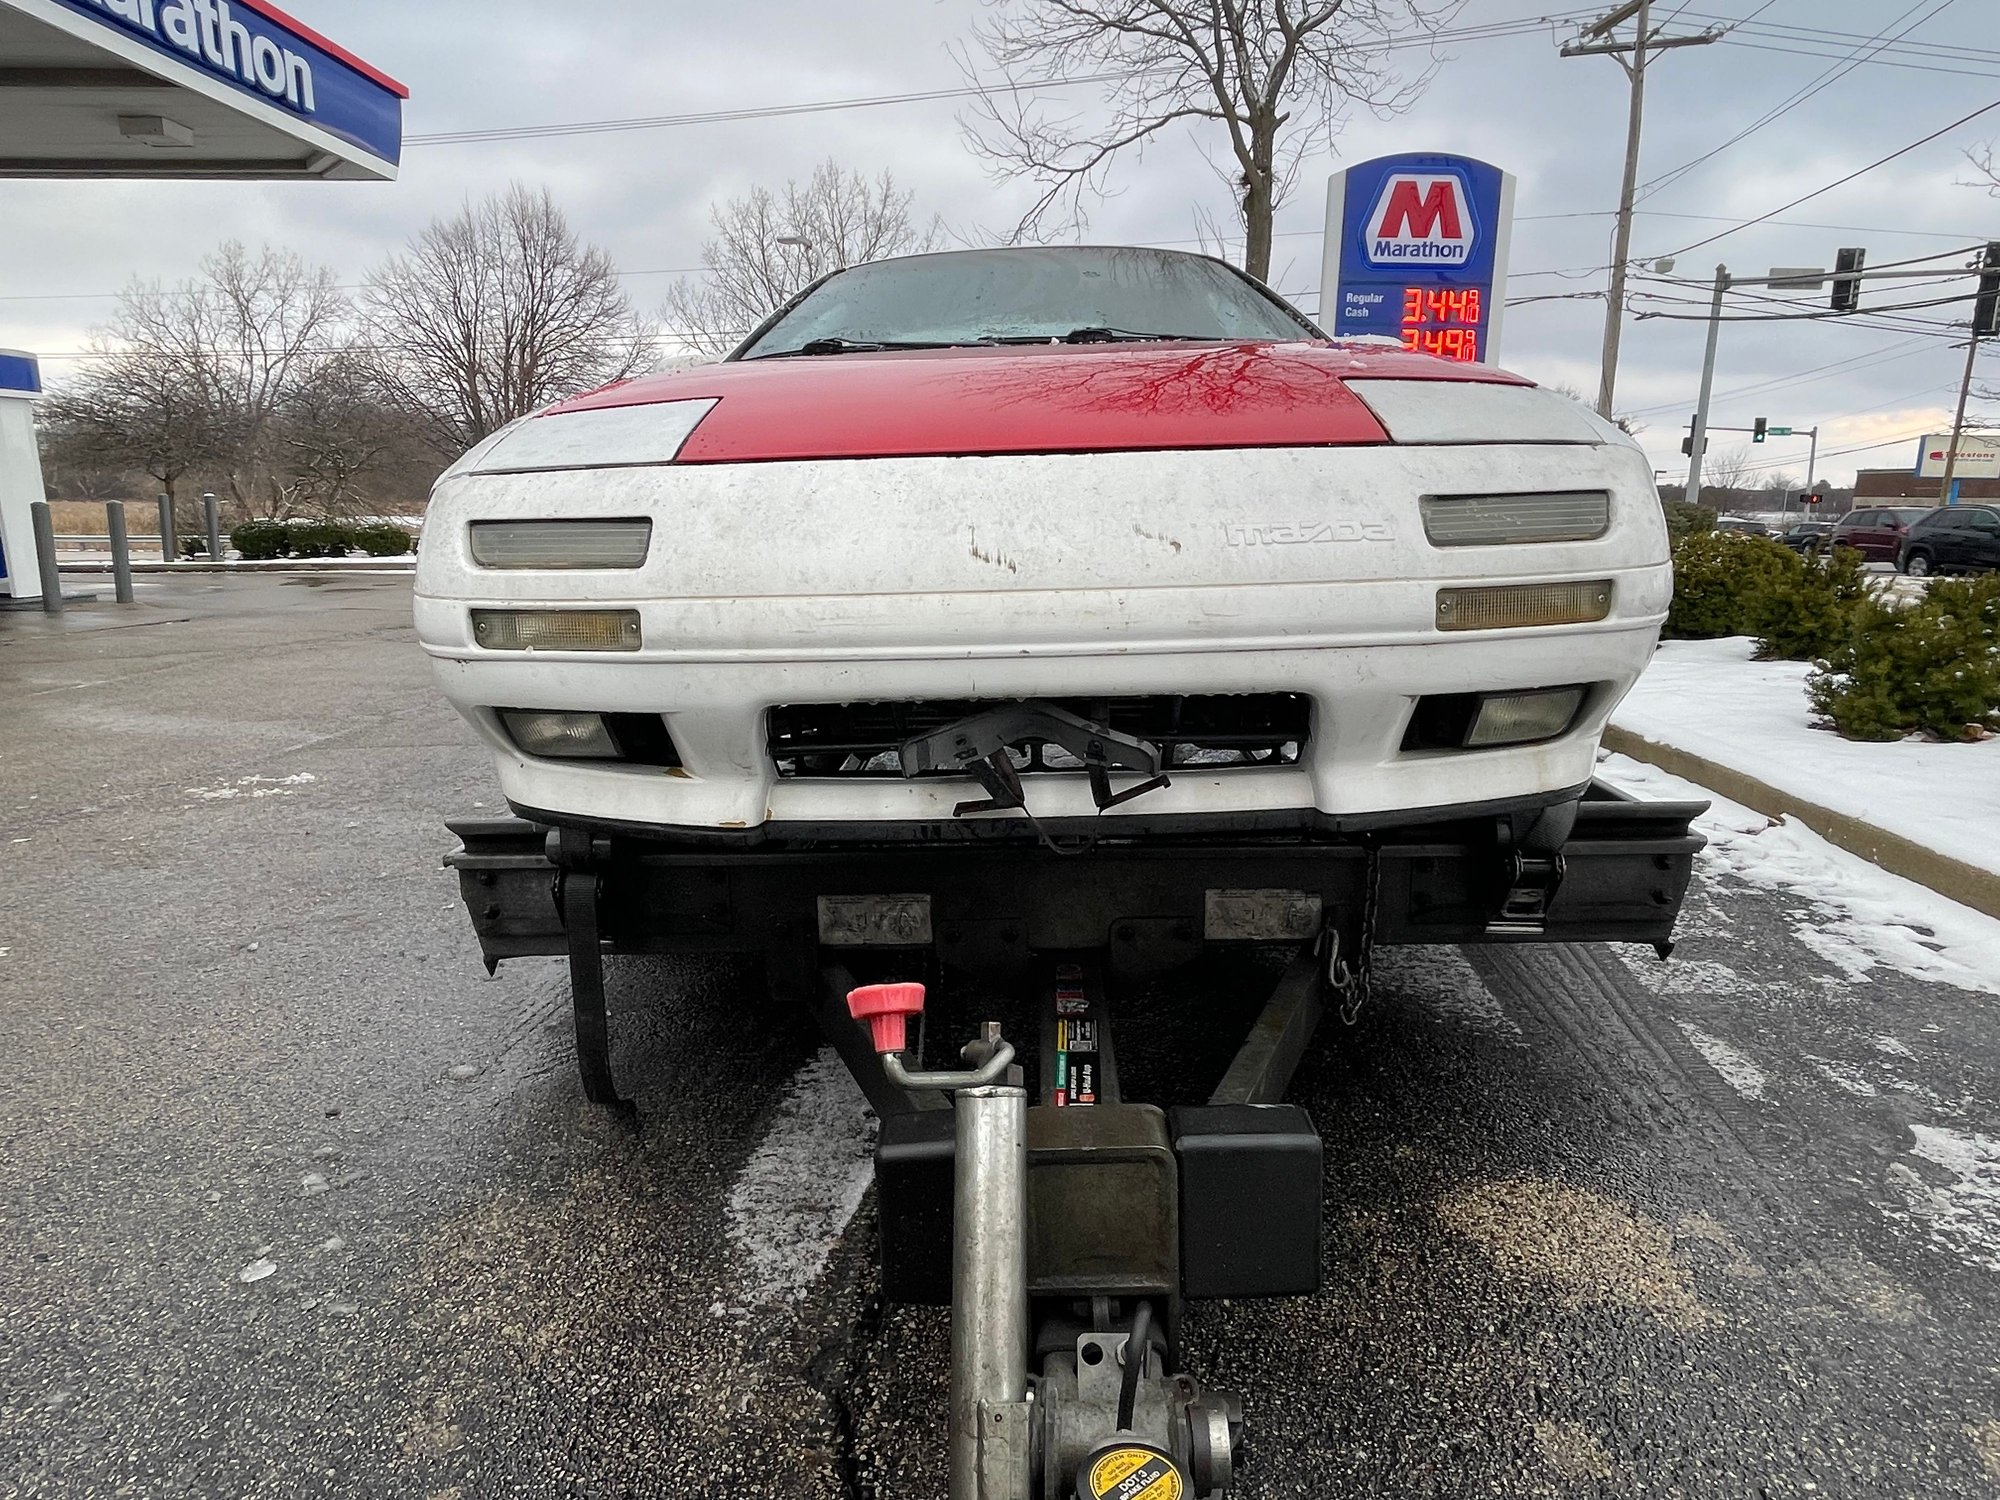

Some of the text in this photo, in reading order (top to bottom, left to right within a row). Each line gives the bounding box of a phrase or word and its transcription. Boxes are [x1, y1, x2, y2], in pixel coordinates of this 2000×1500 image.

[86, 0, 315, 112] rathon
[1377, 181, 1463, 239] M
[1373, 240, 1464, 258] Marathon
[1346, 292, 1385, 305] Regular
[1345, 307, 1369, 318] Cash
[1946, 451, 1996, 459] Frestone
[1118, 1469, 1148, 1492] DOT 3
[1119, 1470, 1161, 1500] BRAKE FLUID
